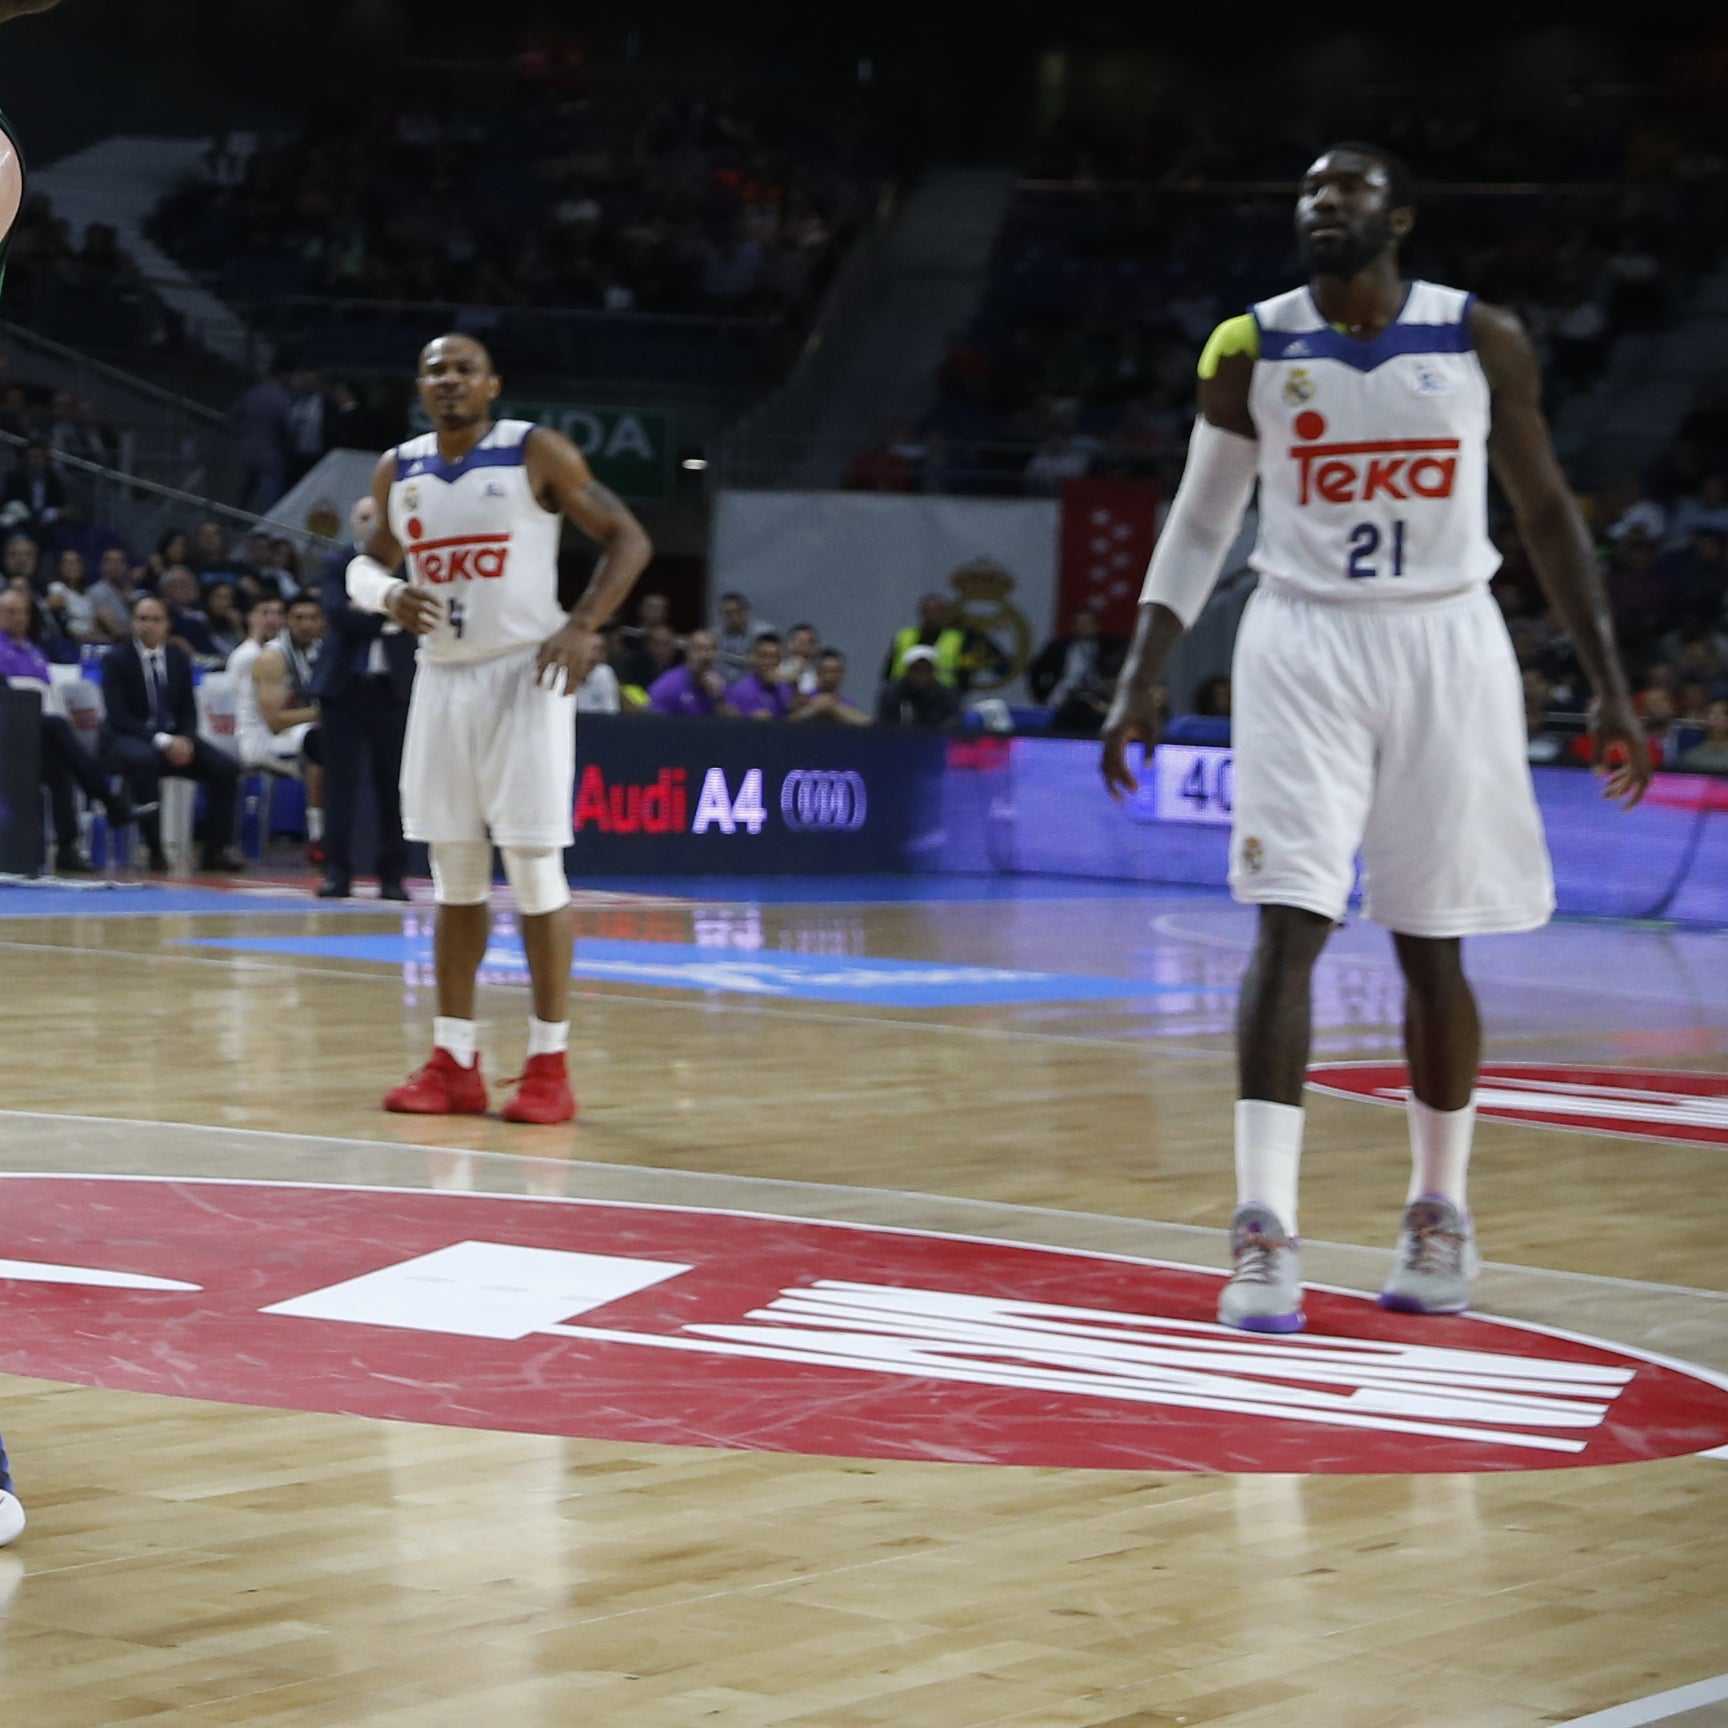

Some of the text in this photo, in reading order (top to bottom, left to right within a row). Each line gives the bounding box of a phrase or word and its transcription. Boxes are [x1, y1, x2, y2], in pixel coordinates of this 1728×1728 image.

[1347, 520, 1404, 578] 21
[573, 764, 768, 834] Audi A4
